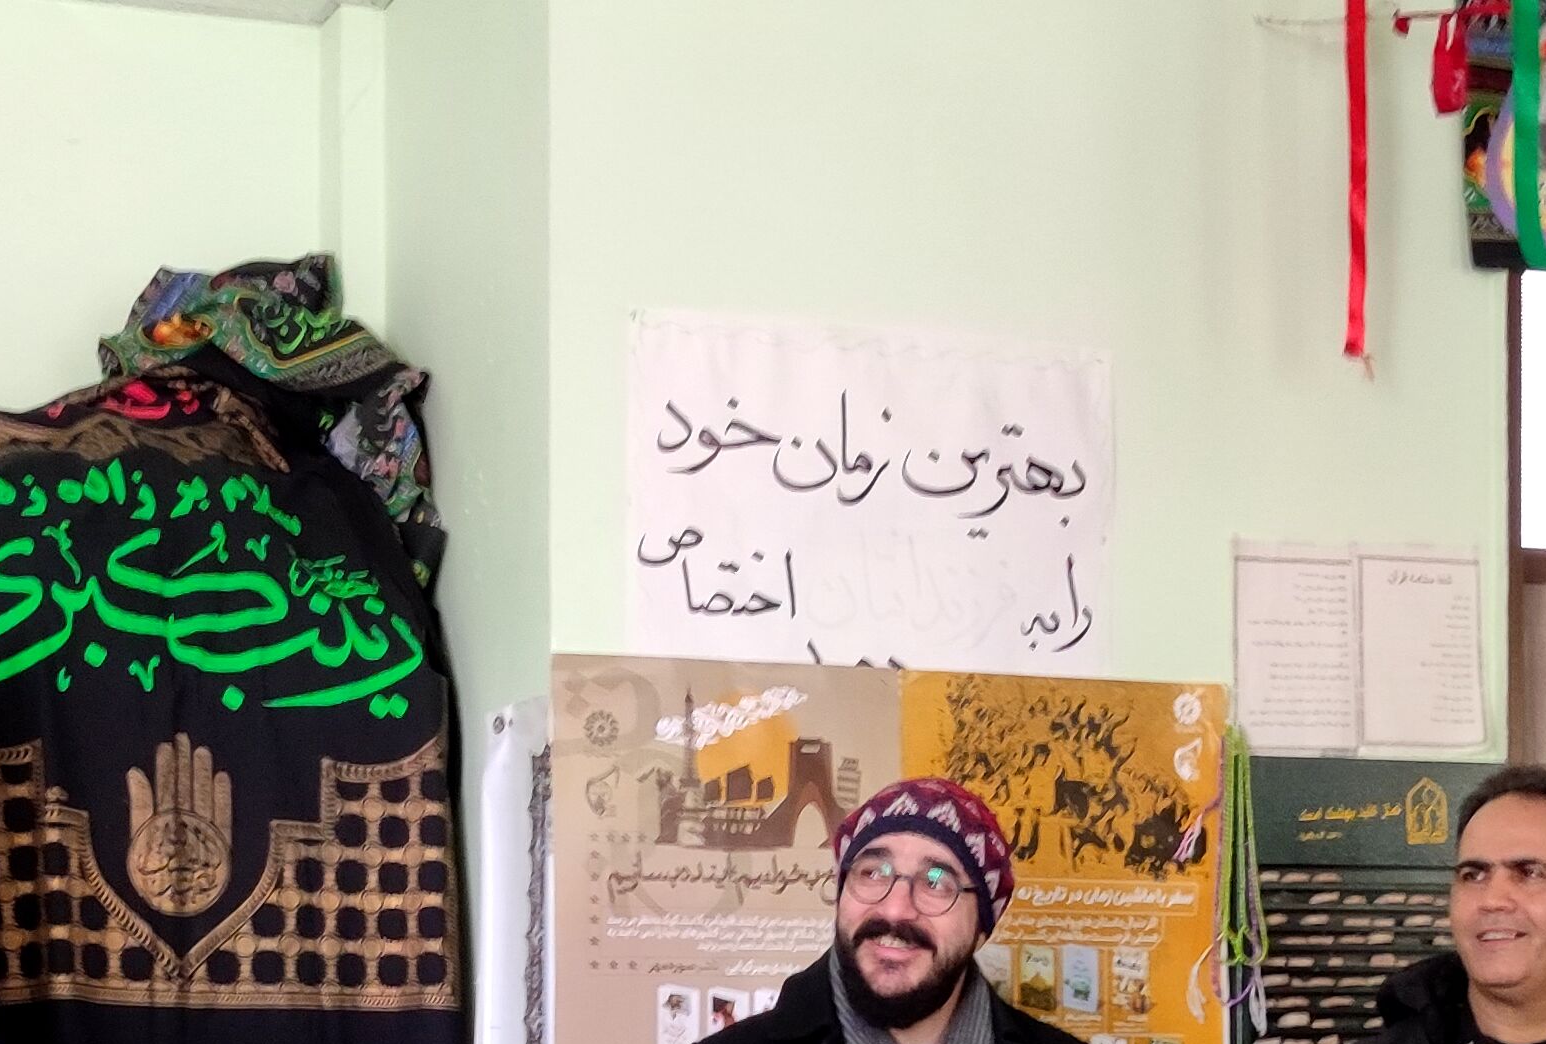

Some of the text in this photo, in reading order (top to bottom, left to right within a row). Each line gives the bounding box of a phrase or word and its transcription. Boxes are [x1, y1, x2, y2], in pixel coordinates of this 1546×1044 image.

[170, 474, 209, 519] بر
[657, 389, 1087, 540] بهترین زمان خود
[637, 524, 797, 620] اختصاص
